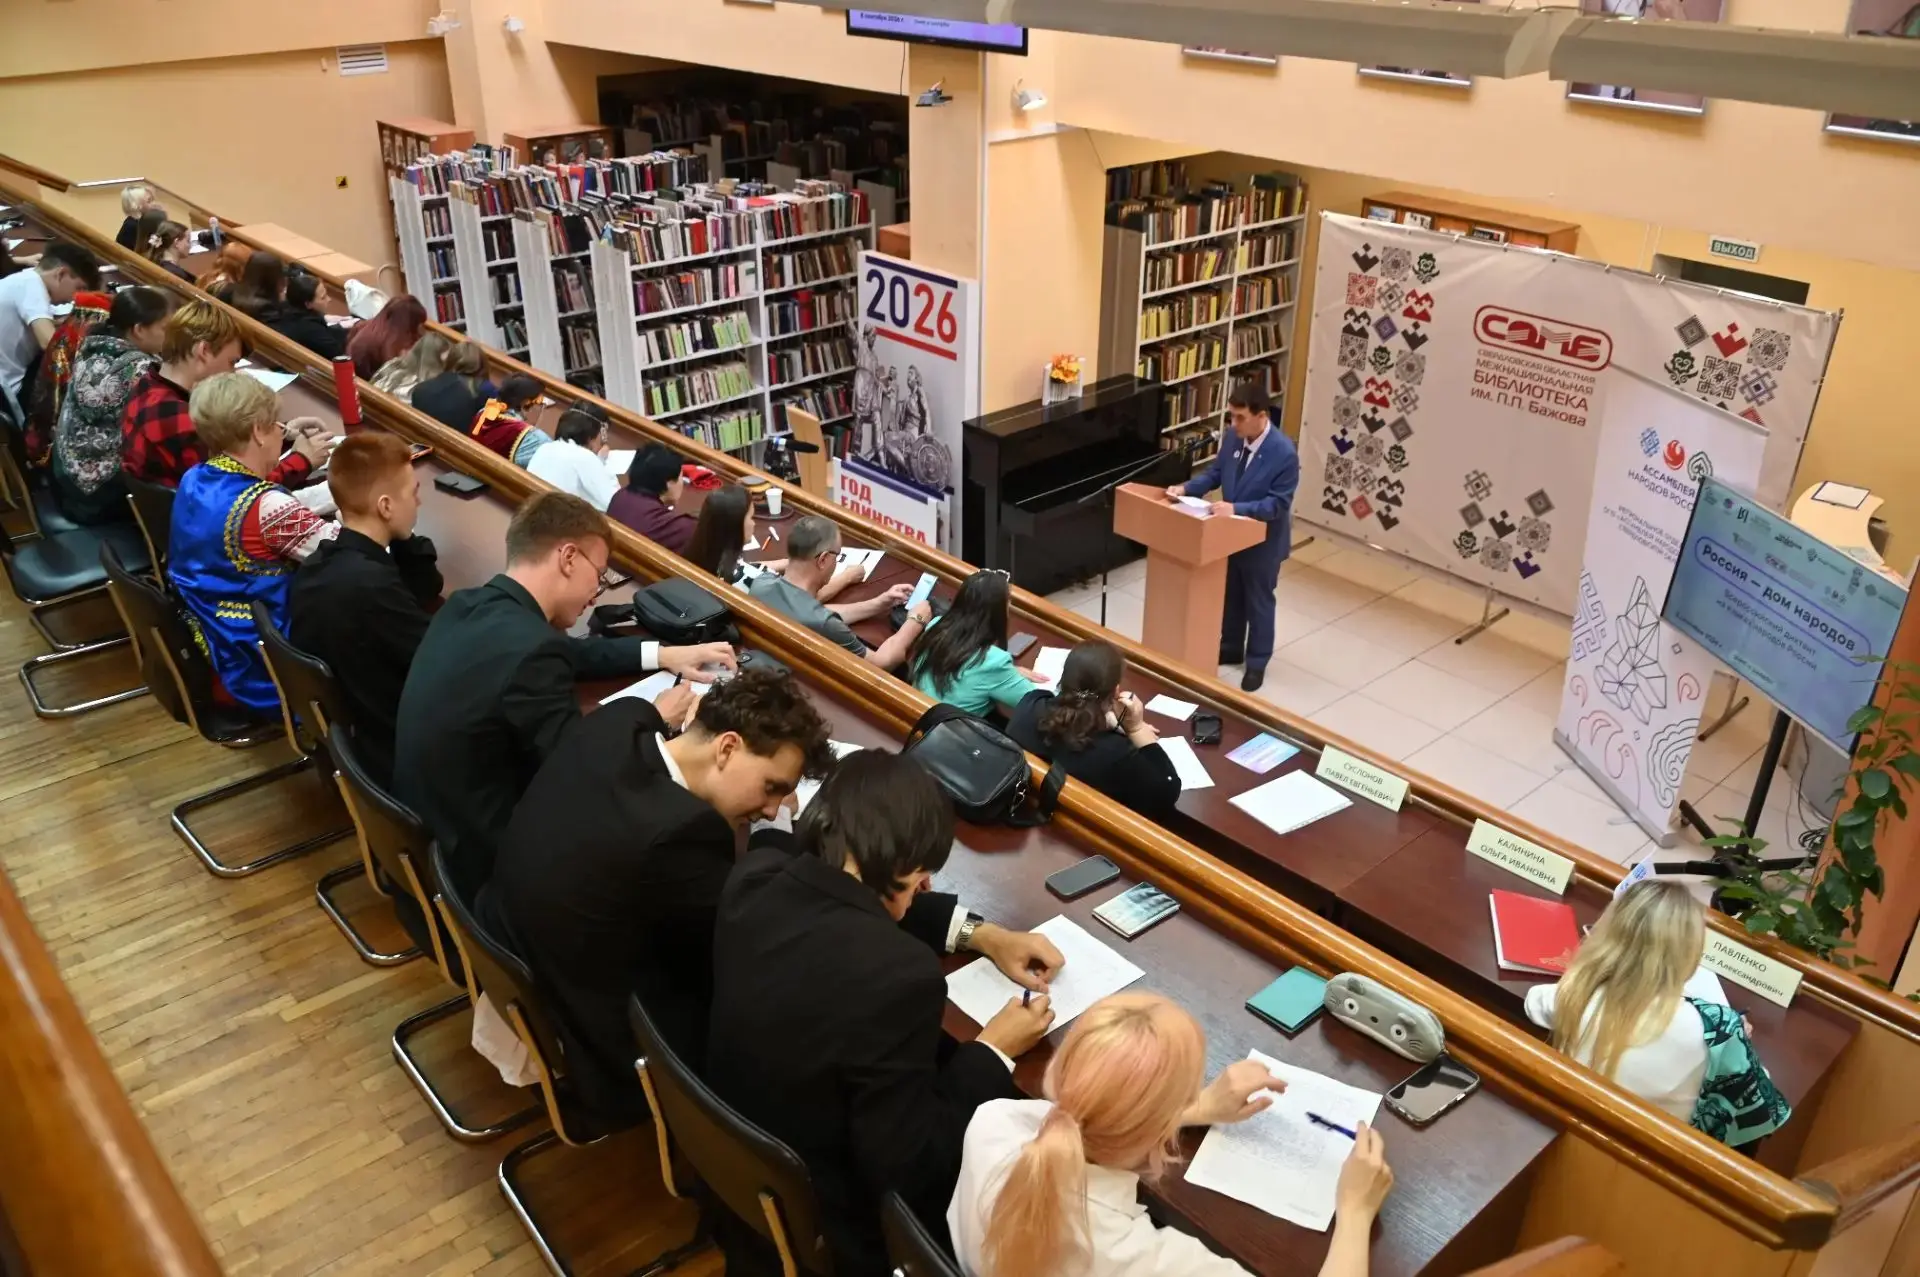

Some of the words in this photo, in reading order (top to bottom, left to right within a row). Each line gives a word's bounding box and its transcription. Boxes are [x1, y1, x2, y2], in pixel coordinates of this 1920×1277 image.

[1713, 241, 1754, 259] ВЫХОД
[866, 269, 957, 344] 2026
[1475, 358, 1594, 395] МЕЖНАЦИОНАЛЬНАЯ
[1477, 348, 1543, 370] СВЕРДЛОВСКАЯ
[1543, 364, 1596, 384] ОБЛАСТНАЯ
[1473, 369, 1588, 412] БИБЛИОТЕКА
[1528, 401, 1586, 427] Бажова
[841, 474, 871, 505] ГОД
[1628, 469, 1668, 497] НАРОДОВ
[1670, 494, 1694, 512] РОСС
[1643, 464, 1695, 498] АССАМБЛЕЯ
[1702, 544, 1748, 582] Россия
[1794, 604, 1856, 651] народов
[1325, 767, 1348, 782] ПАВЕЛ
[1350, 777, 1395, 804] ЕВГЕНЬЕВИЧ
[1344, 762, 1384, 785] СУСЛОНОВ
[1480, 845, 1507, 861] ОЛЬГА
[1509, 858, 1556, 885] ИВАНОВНА
[1497, 837, 1545, 865] КАЛИНИНА
[1713, 941, 1767, 972] ПАВЛЕНКО
[1717, 959, 1783, 997] Александрович
